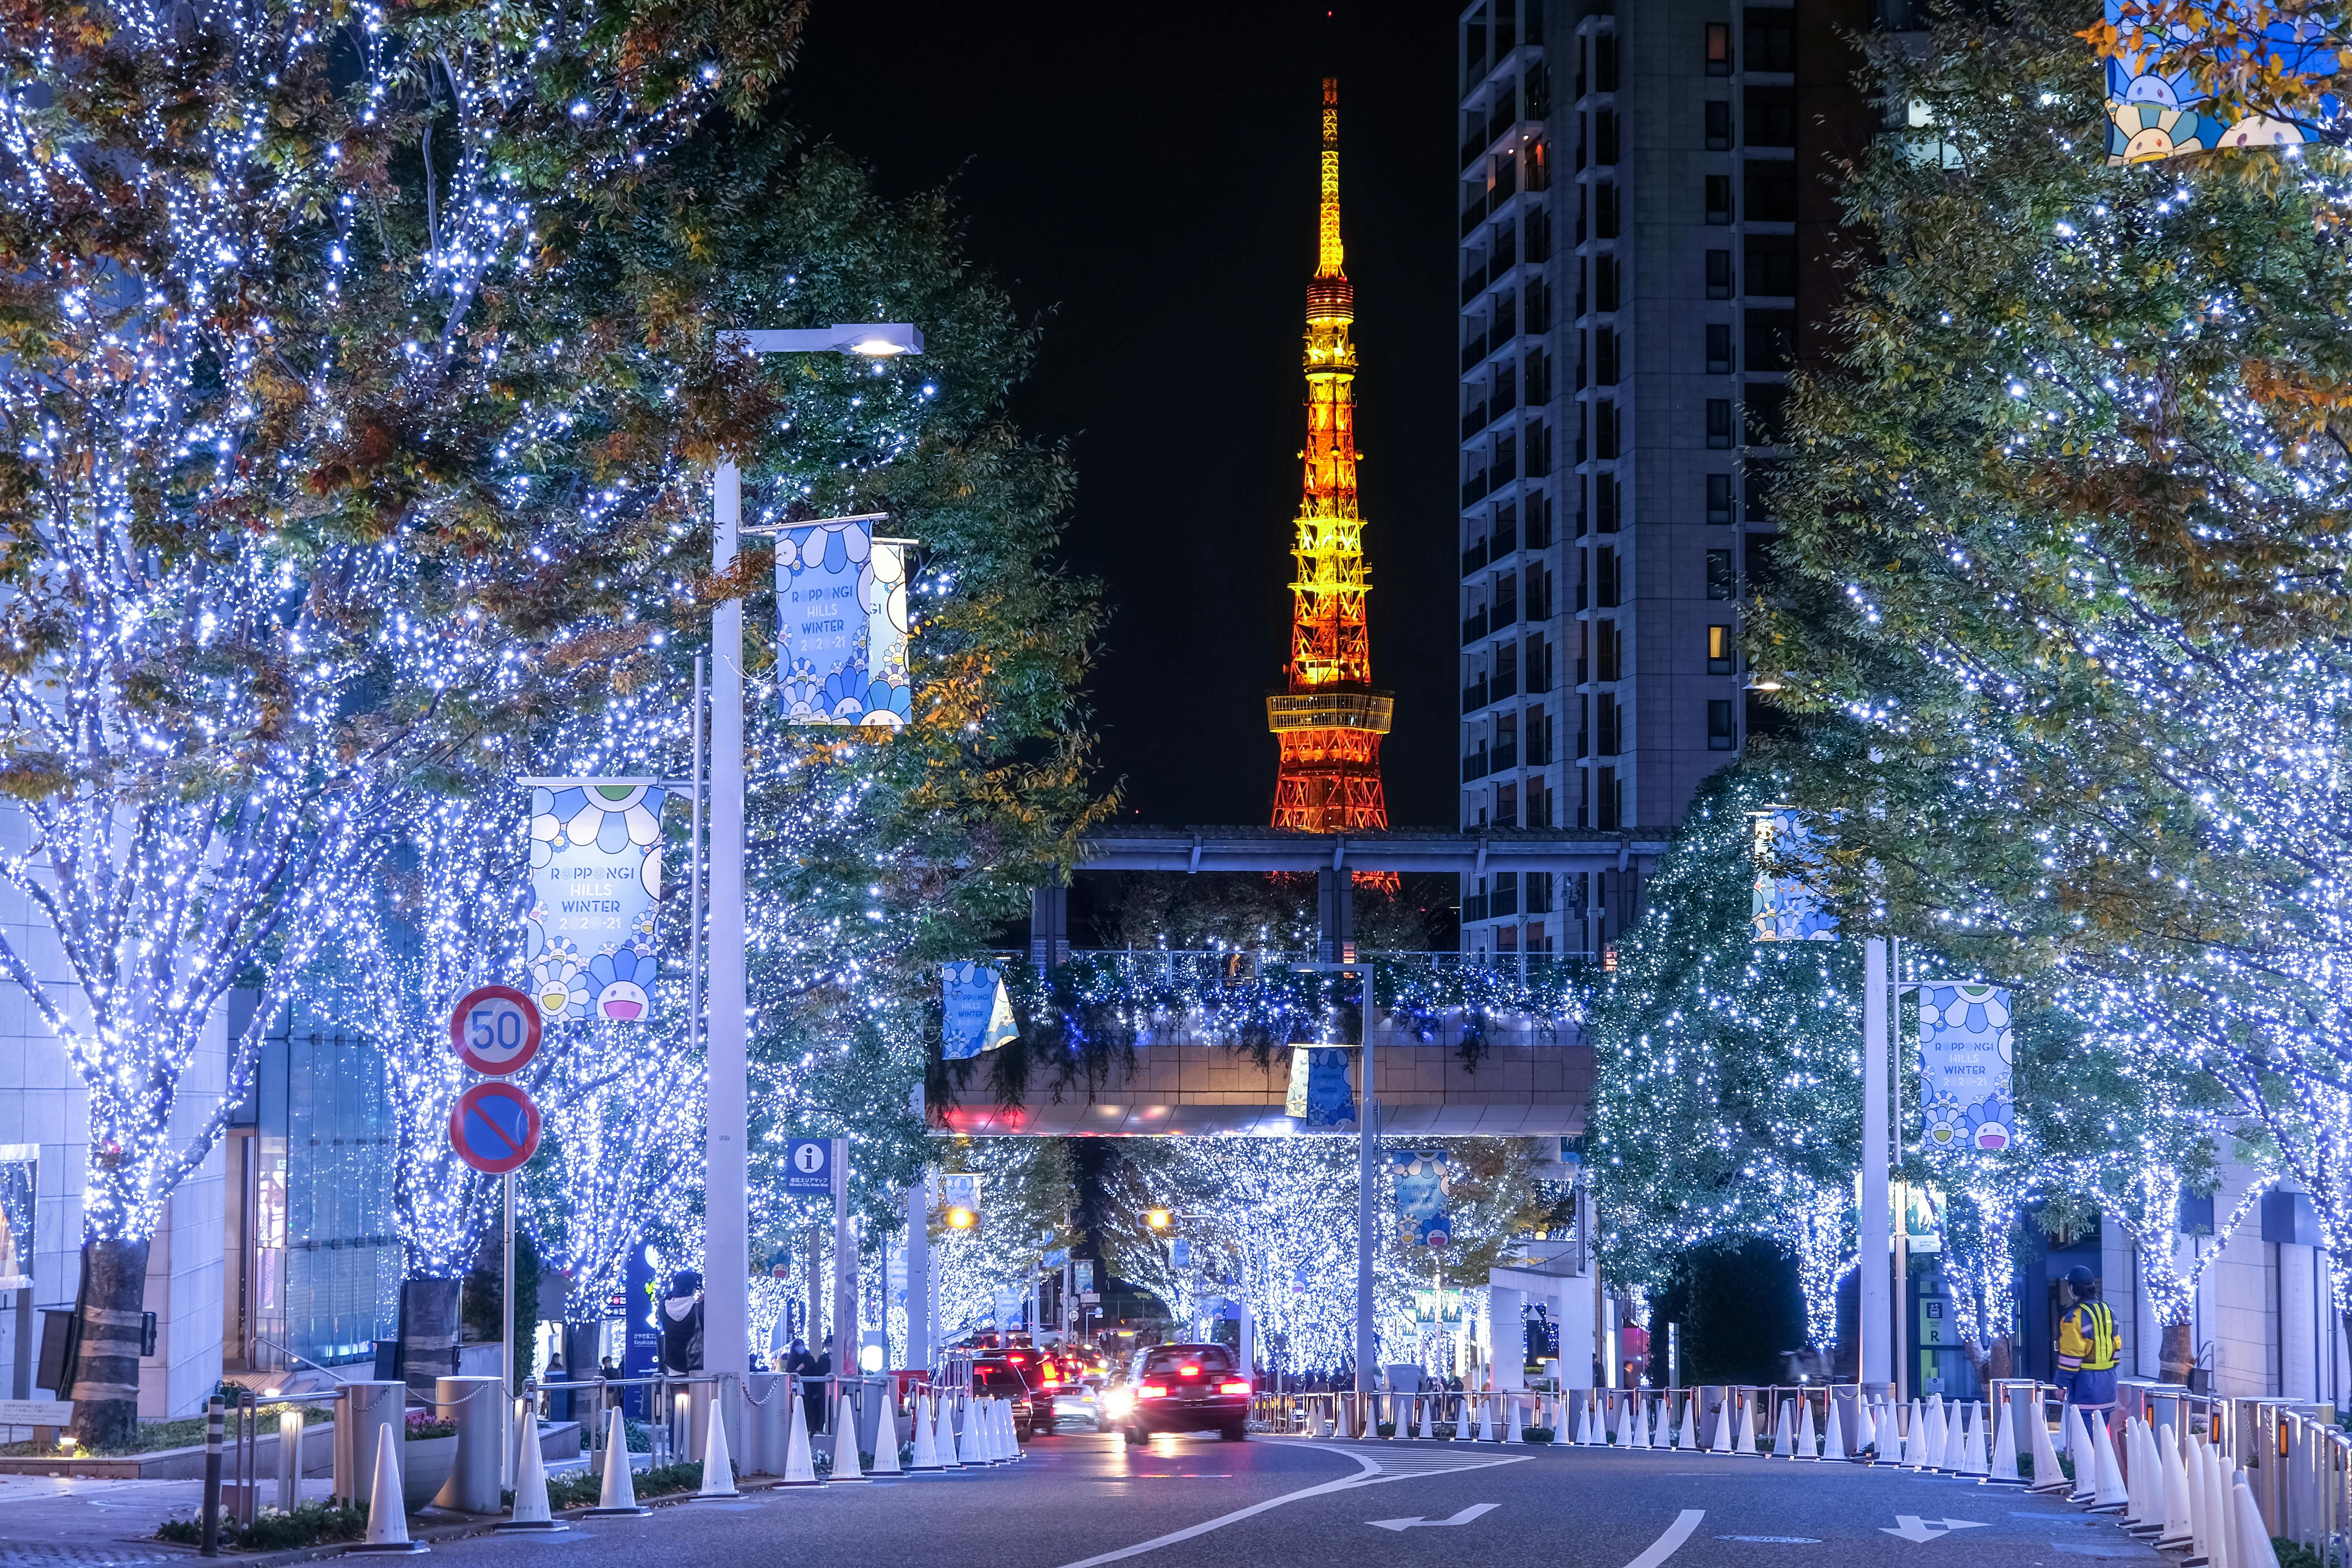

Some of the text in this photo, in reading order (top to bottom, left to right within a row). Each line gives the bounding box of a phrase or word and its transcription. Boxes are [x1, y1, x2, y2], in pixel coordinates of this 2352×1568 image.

[807, 603, 838, 618] HILLS
[802, 619, 844, 635] WINTER
[551, 867, 634, 880] ROPPONGI
[570, 883, 612, 896] HILLS
[561, 900, 620, 913] WINTER
[559, 916, 621, 930] 2020-21
[472, 1011, 521, 1049] 50
[1949, 1054, 1979, 1063] HILLS
[1944, 1066, 1985, 1074] WINTER
[1931, 1330, 1940, 1341] R
